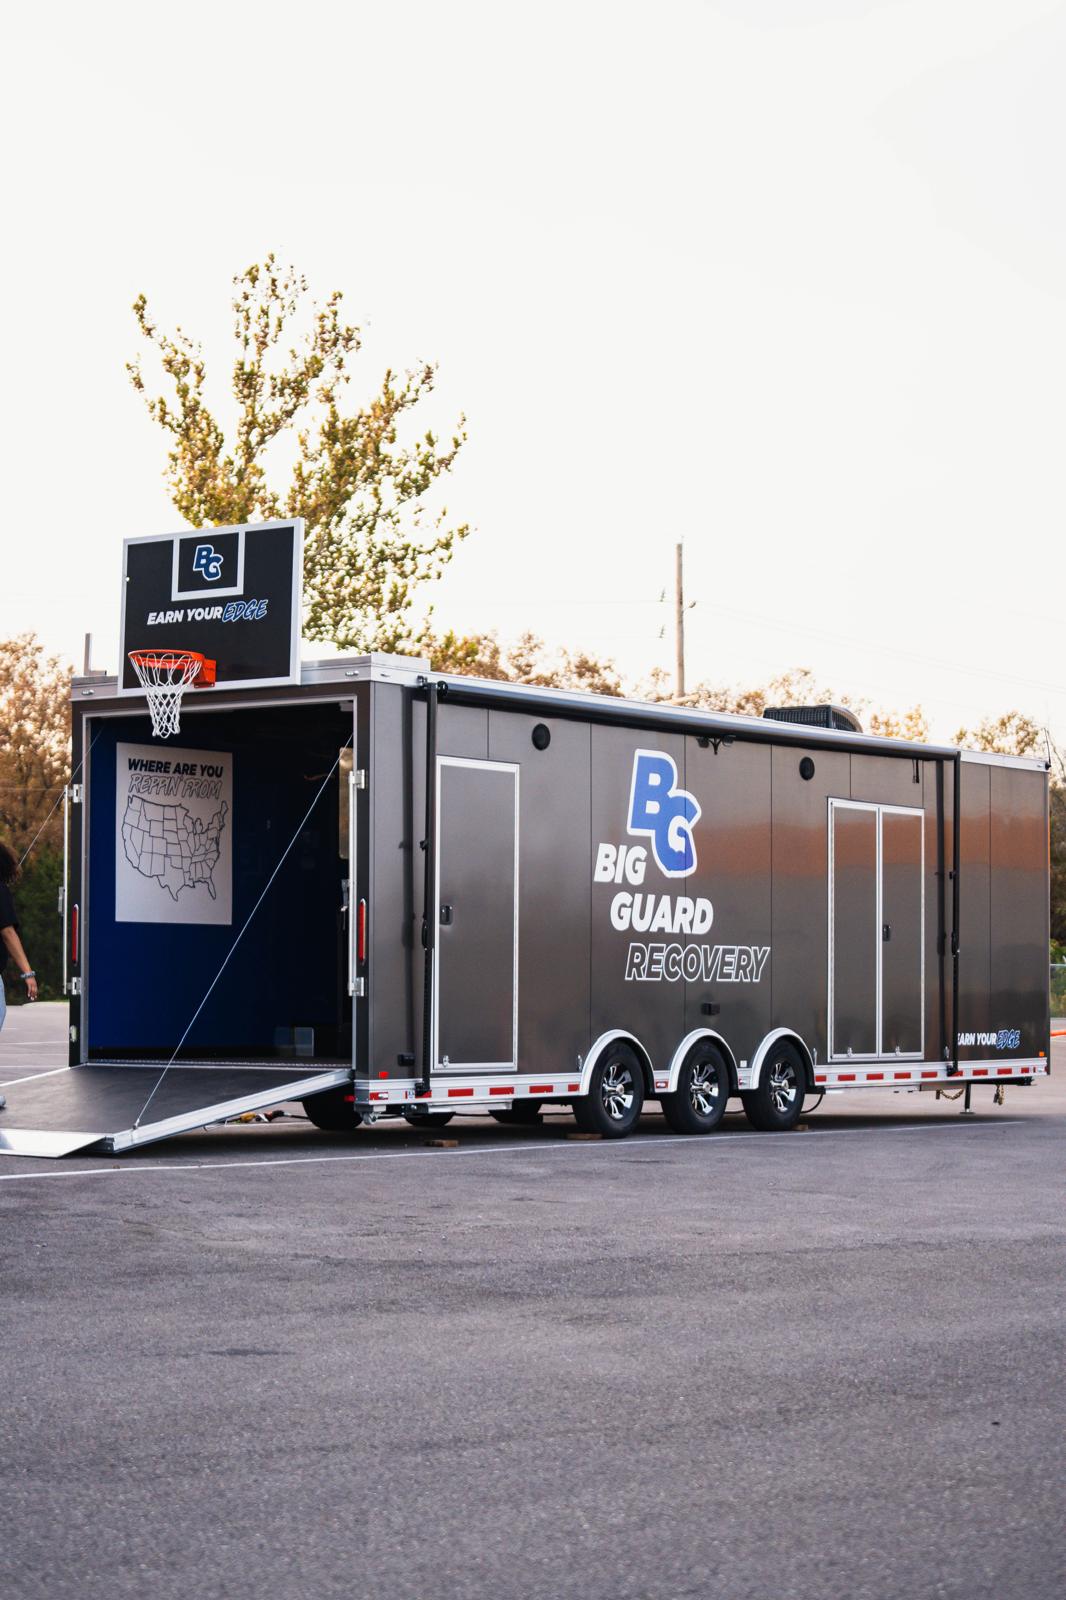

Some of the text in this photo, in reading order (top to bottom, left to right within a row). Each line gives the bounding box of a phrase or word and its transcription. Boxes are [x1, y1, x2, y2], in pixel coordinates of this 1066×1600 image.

[147, 599, 268, 625] EARN YOUR EDGE
[128, 758, 223, 778] WHERE ARE YOU
[182, 777, 222, 800] FROM
[594, 843, 648, 885] BIG
[610, 892, 714, 935] GUARD
[625, 943, 770, 982] RECOVERY
[976, 1032, 997, 1045] YOUR
[996, 1029, 1020, 1049] EDGE
